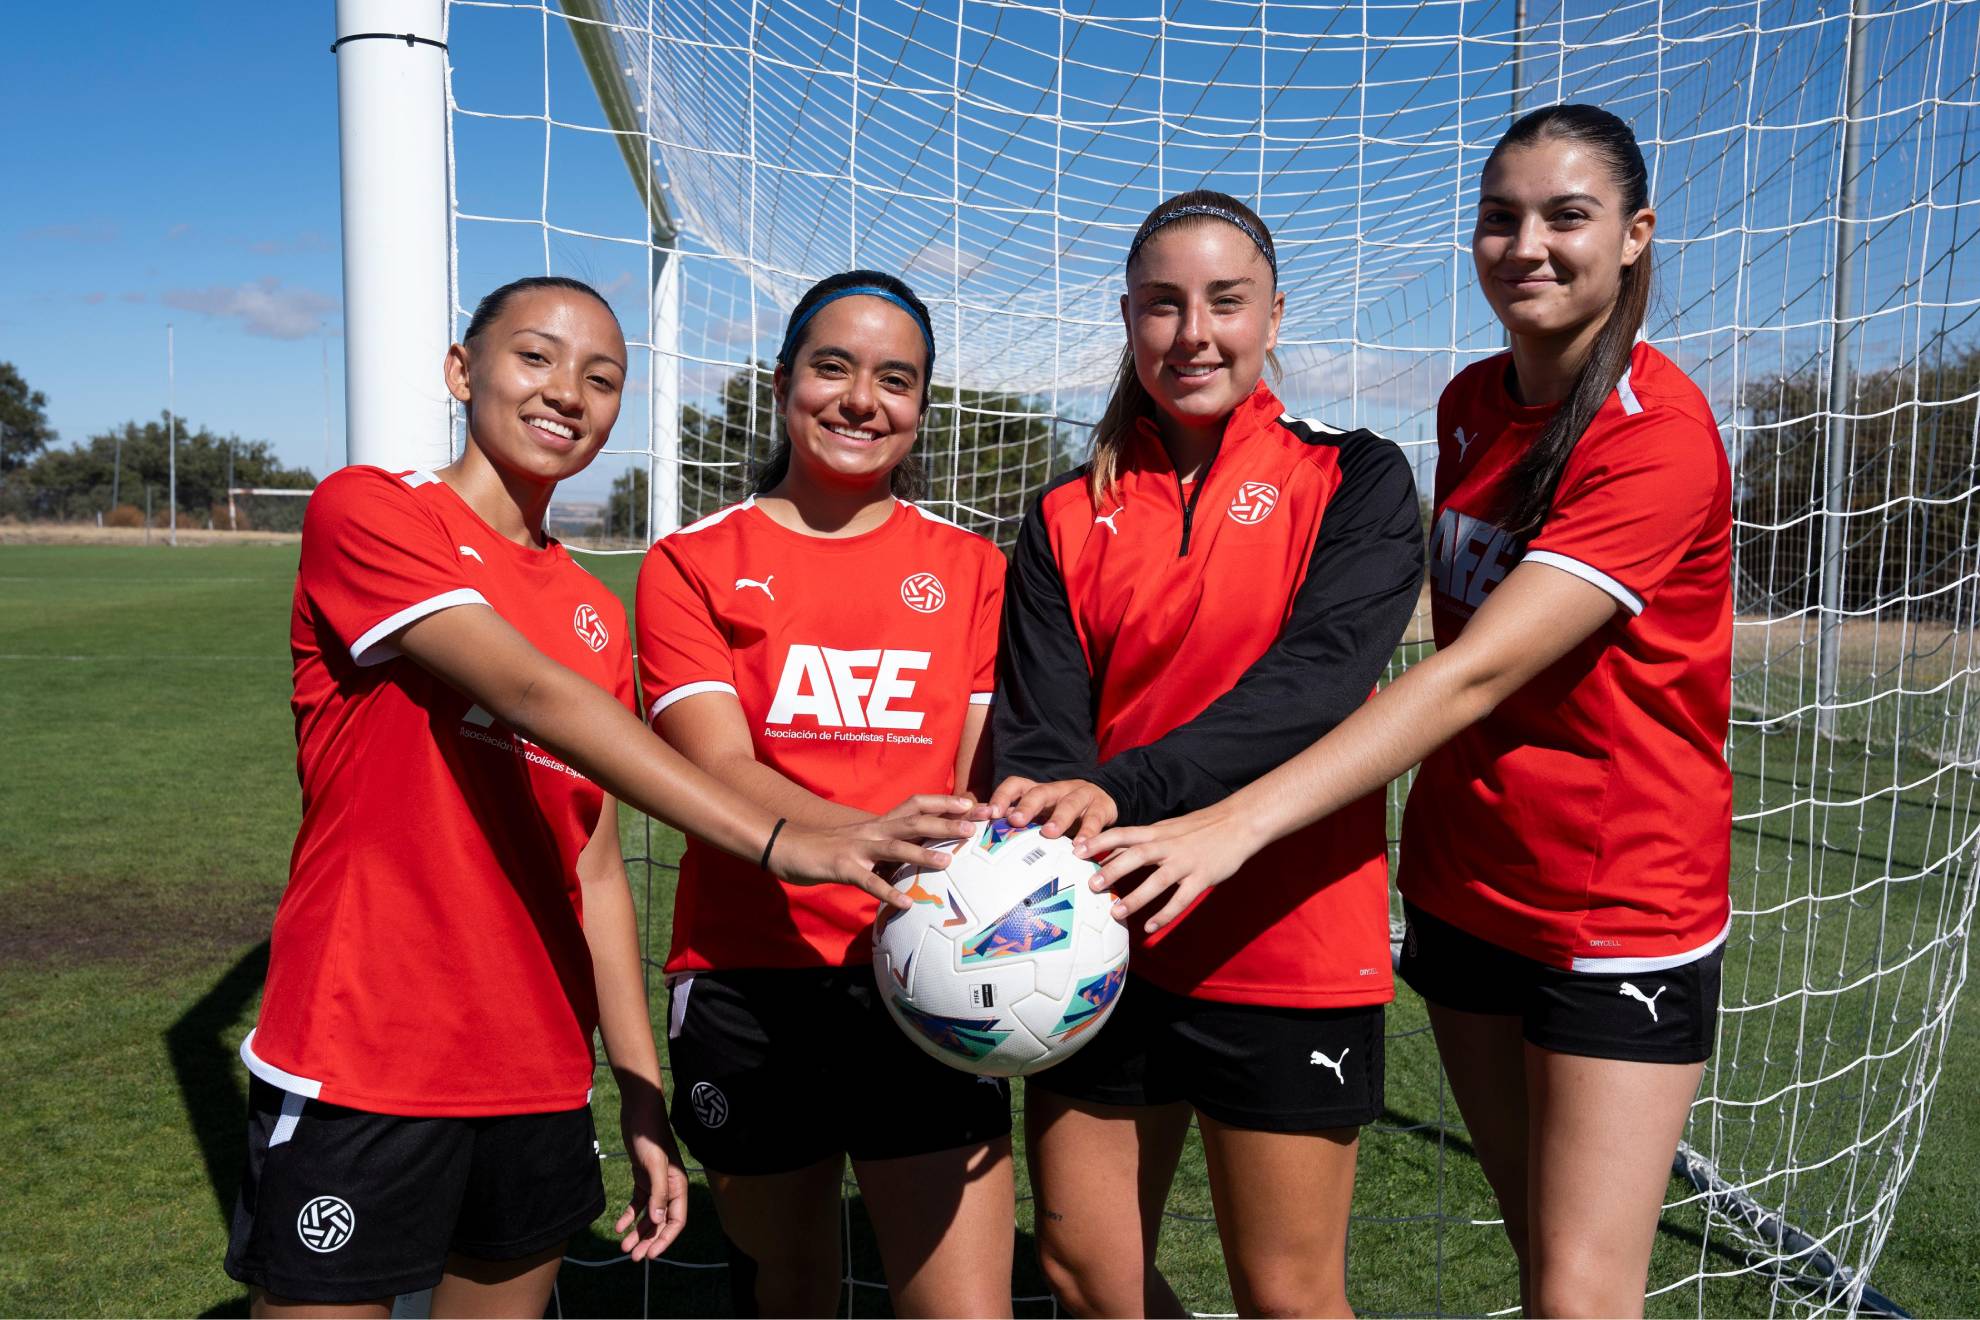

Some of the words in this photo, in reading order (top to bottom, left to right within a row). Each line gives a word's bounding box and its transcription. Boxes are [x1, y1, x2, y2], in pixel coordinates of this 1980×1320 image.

[1430, 507, 1518, 608] AFE
[765, 644, 932, 730] AFE
[764, 727, 817, 740] Asociación
[819, 731, 832, 740] de
[834, 731, 884, 742] Futbolistas
[886, 733, 933, 745] Españoles
